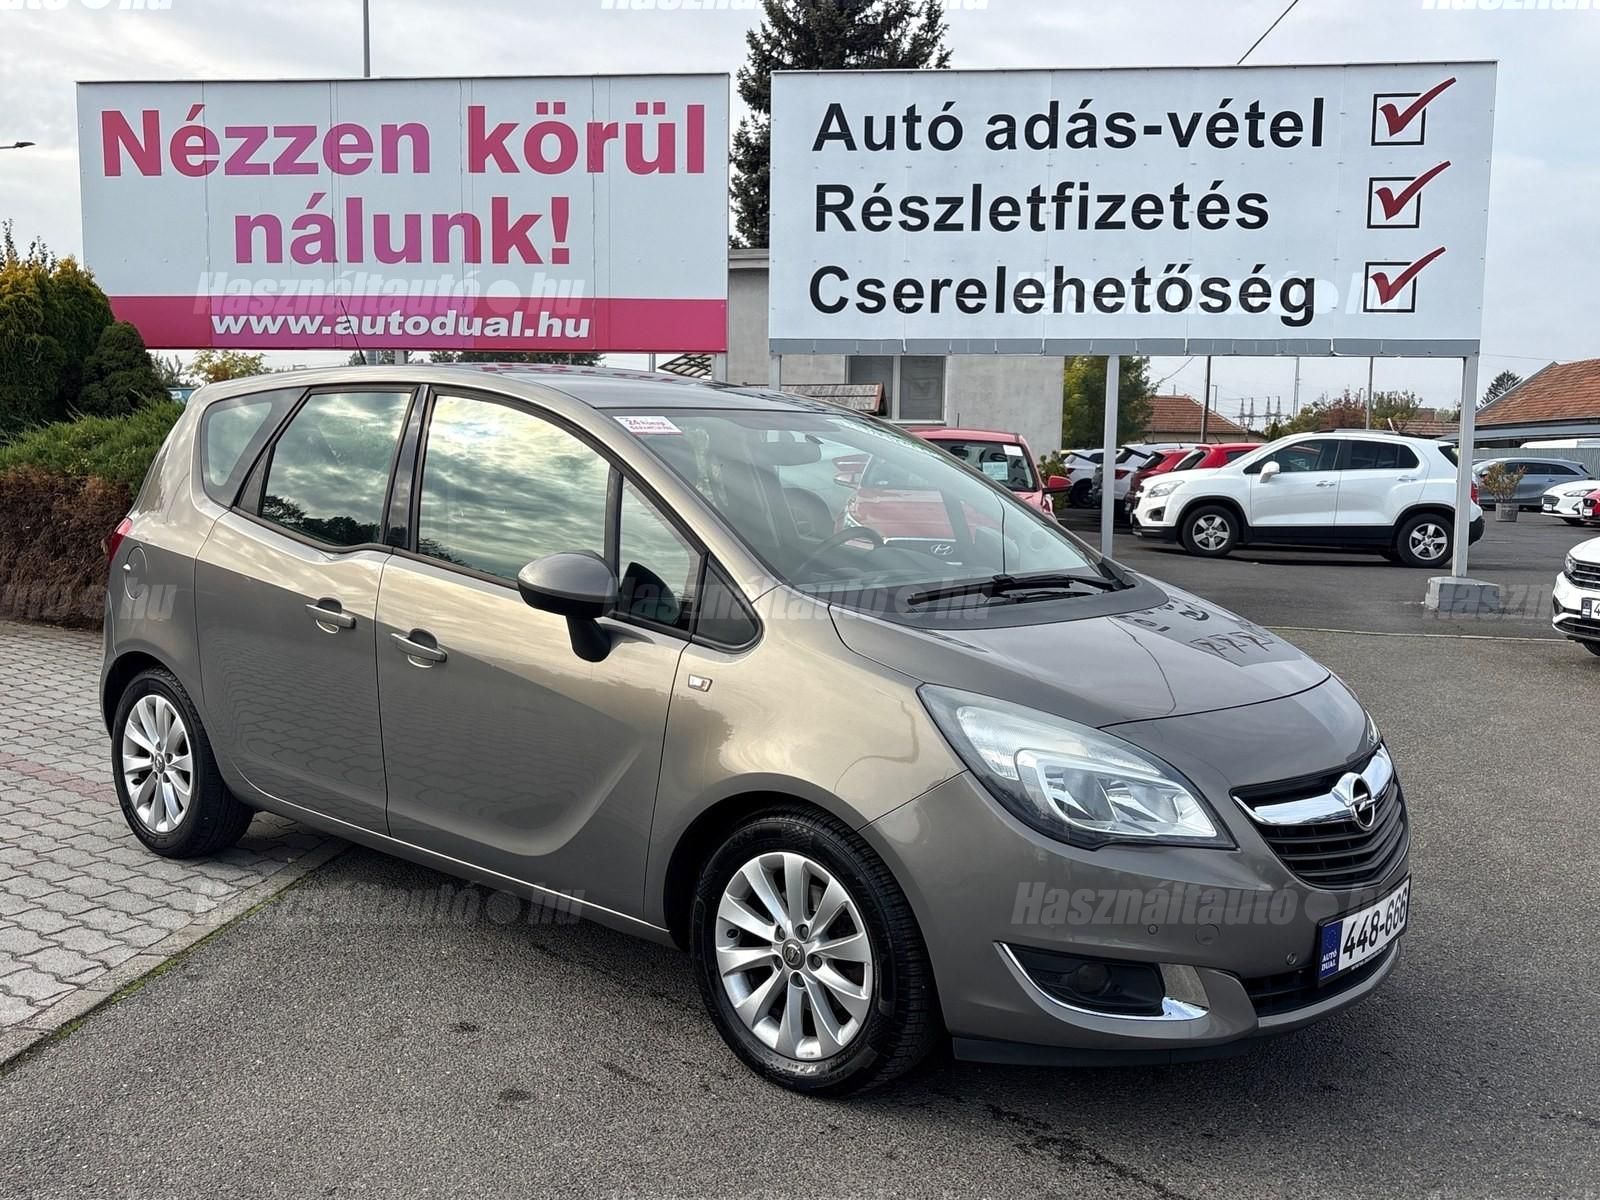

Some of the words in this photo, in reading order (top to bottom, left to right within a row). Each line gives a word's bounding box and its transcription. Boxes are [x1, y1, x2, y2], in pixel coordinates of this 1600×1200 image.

[101, 104, 430, 177] Nézzen
[468, 102, 705, 175] körül
[812, 102, 963, 152] Autó
[985, 98, 1324, 151] adás-vétel
[235, 193, 571, 264] nálunk!
[816, 181, 1270, 232] Részletfizetés
[210, 309, 591, 339] www.autodual.hu
[809, 263, 1316, 327] Cserelehetőség
[1342, 887, 1408, 960] 448-666
[1321, 959, 1337, 972] DUAL
